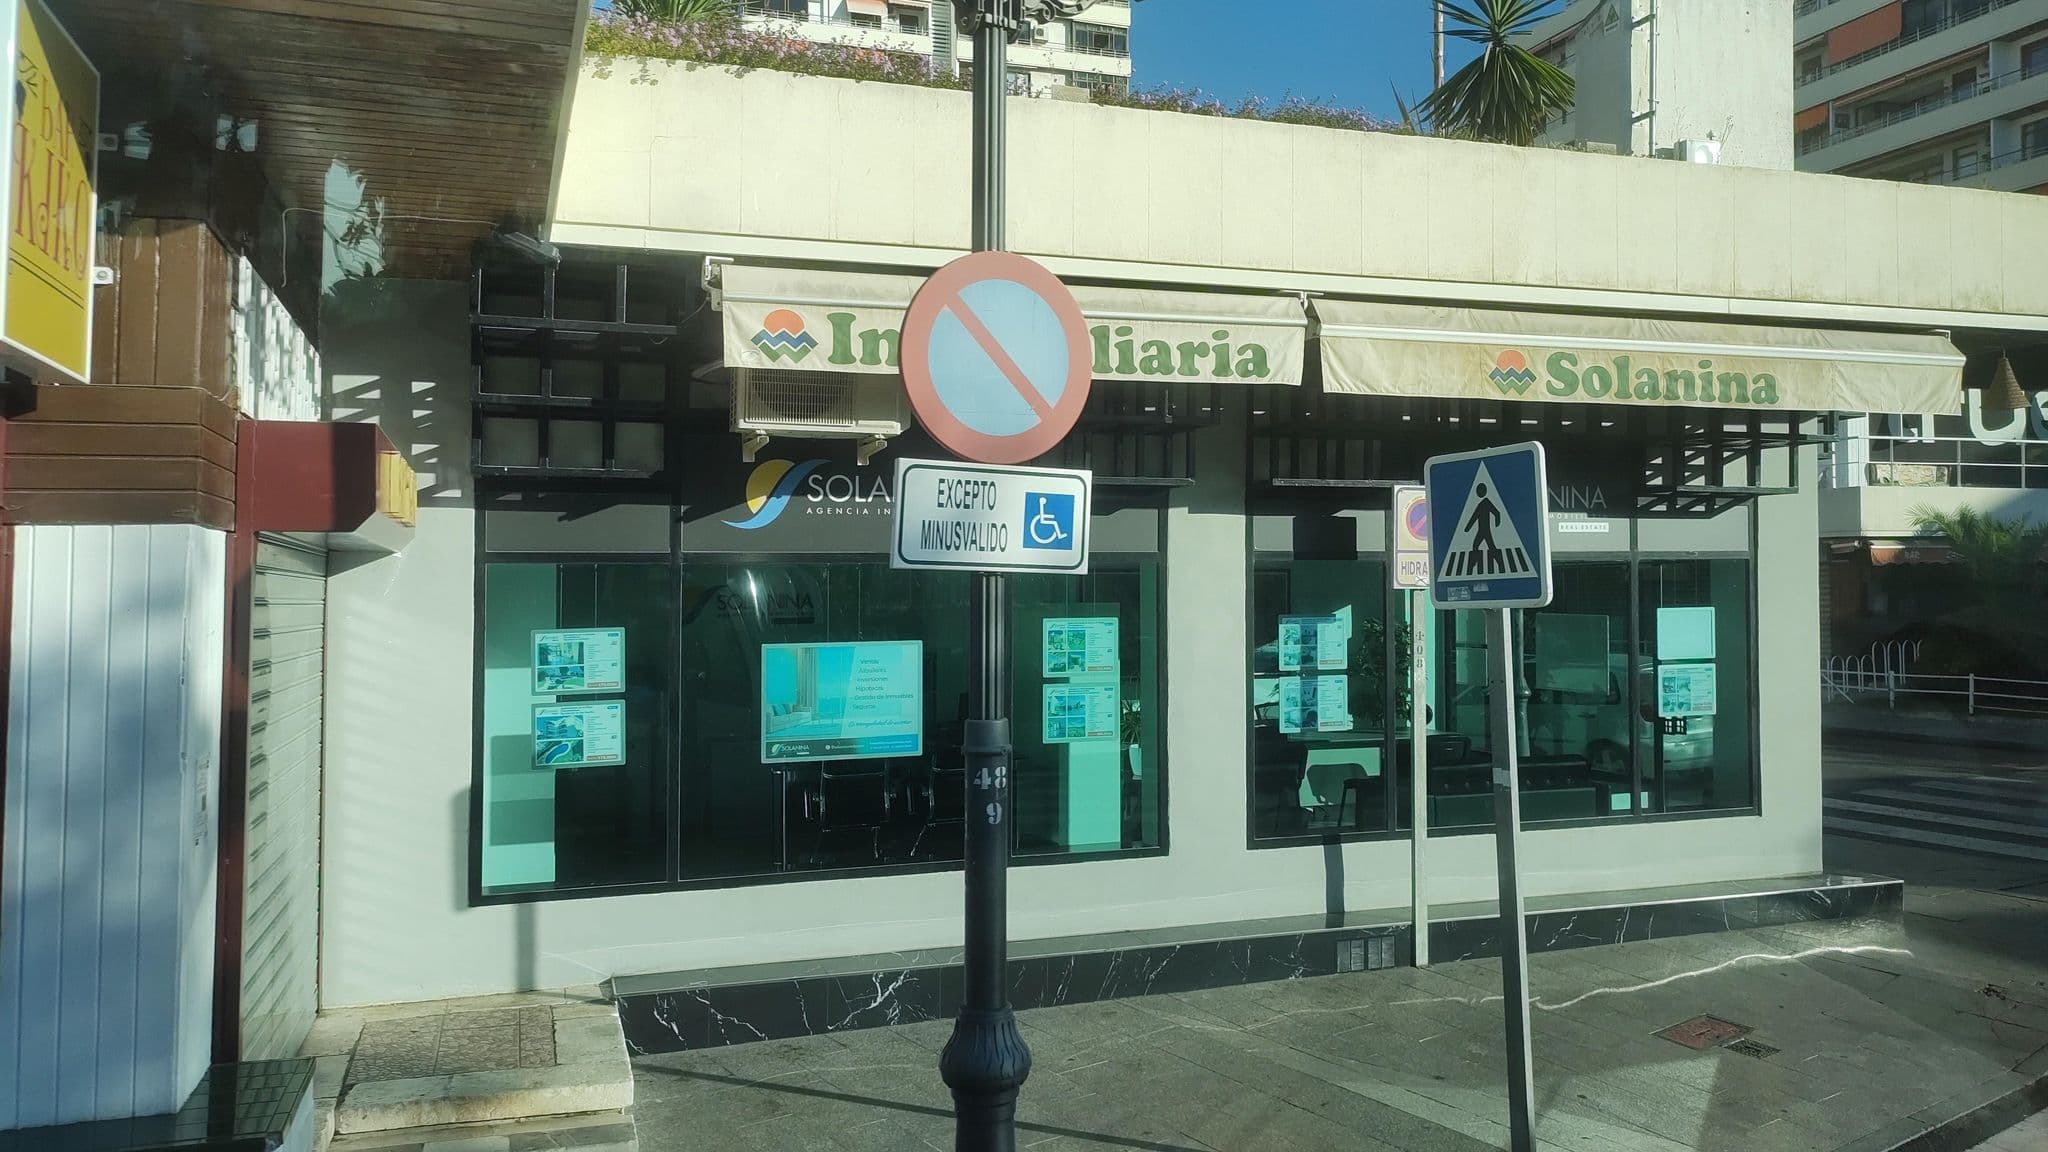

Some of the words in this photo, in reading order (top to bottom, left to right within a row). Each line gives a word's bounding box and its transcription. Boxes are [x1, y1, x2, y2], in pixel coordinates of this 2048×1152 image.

[826, 312, 1271, 379] Inliaria
[1545, 351, 1780, 405] Solanina
[806, 474, 895, 503] SOLA
[937, 478, 997, 511] EXCEPTO
[806, 507, 869, 515] AGENCIA
[920, 519, 1009, 553] MINUSVALIDO
[973, 766, 1007, 790] 48
[986, 802, 1002, 825] 9
